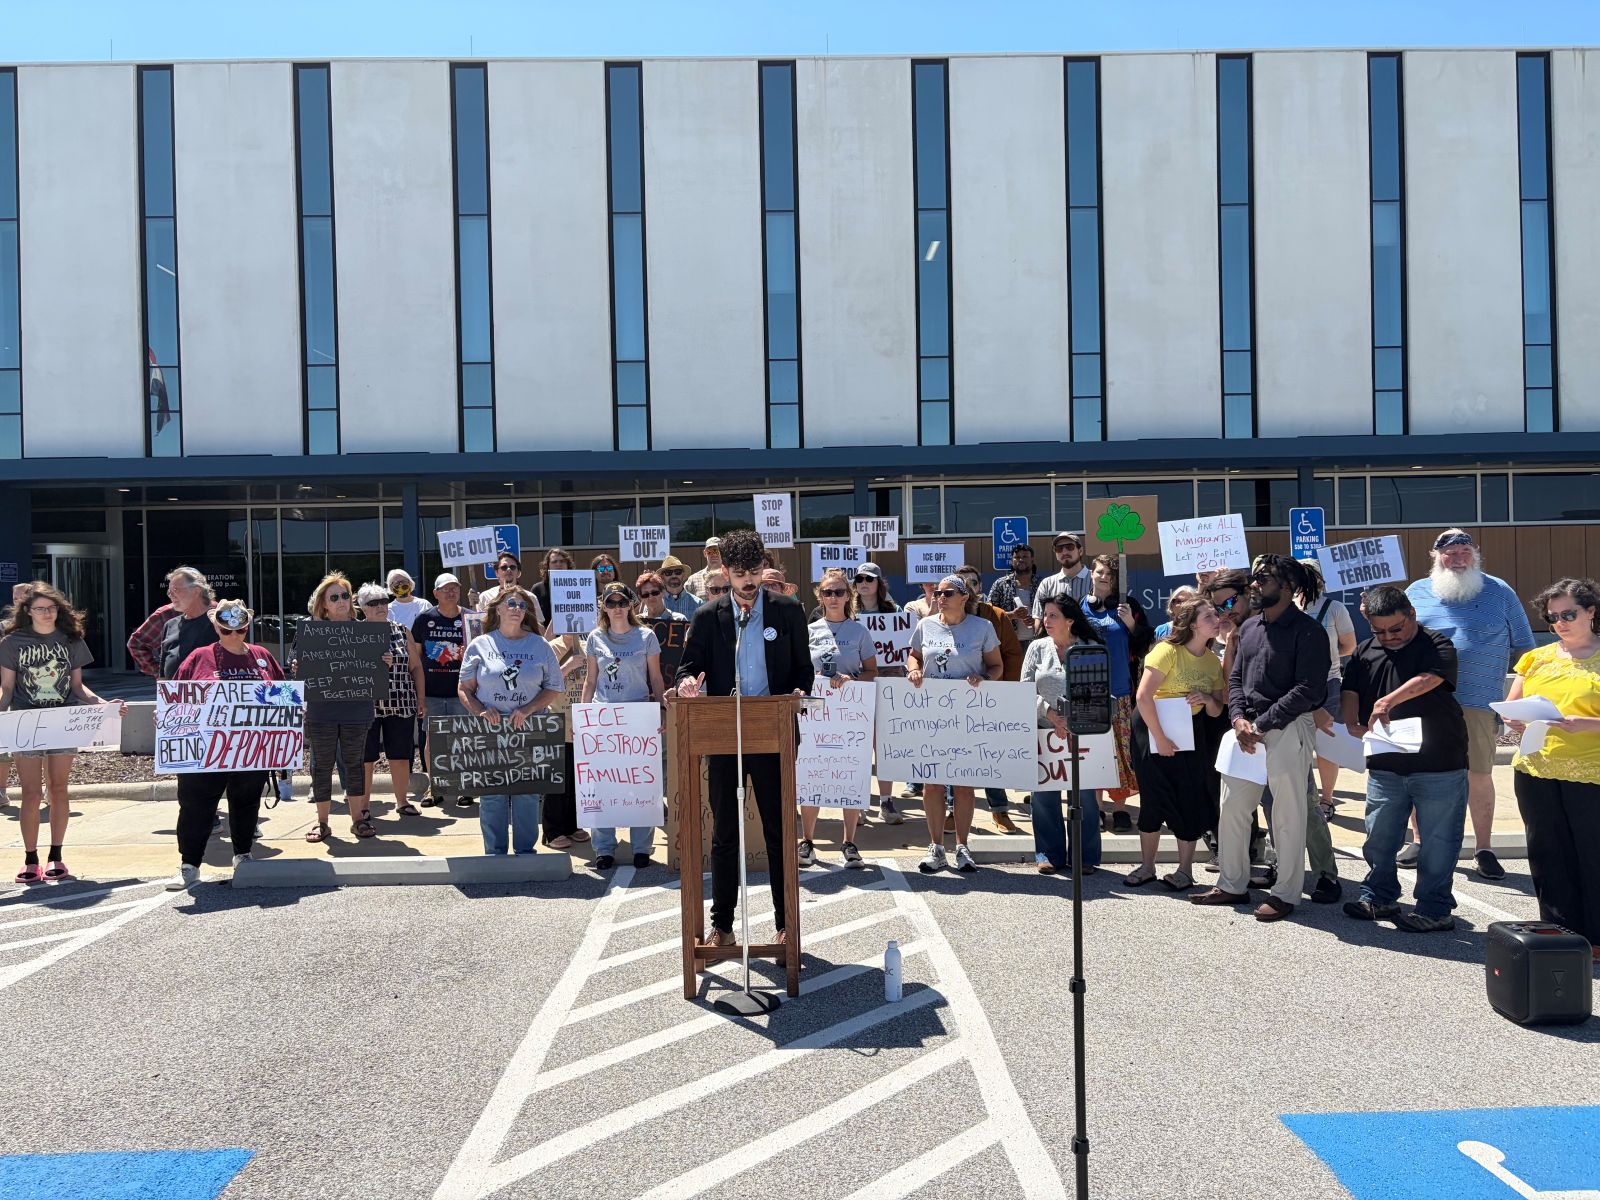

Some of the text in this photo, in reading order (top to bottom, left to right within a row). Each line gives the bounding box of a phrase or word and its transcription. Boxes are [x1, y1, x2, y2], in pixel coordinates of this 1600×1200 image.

[761, 499, 783, 511] STOP
[766, 516, 780, 527] ICE
[854, 520, 896, 532] LET THEM
[1217, 517, 1238, 530] ALL
[623, 528, 666, 540] LET THEM
[862, 533, 888, 550] OUT
[442, 537, 493, 559] ICE OUT
[632, 541, 658, 559] OUT
[820, 546, 859, 560] END ICE
[922, 552, 947, 561] ICE OFF
[1330, 538, 1385, 563] END ICE
[915, 564, 958, 575] OUR STREETS
[1337, 561, 1392, 586] TERROR
[553, 577, 593, 587] HANDS OFF
[566, 590, 581, 600] OUR
[554, 603, 594, 614] NEIGHBORS
[303, 623, 355, 637] AMERICAN
[868, 612, 912, 632] US IN
[430, 630, 463, 638] ILLEGAL
[301, 649, 357, 661] AMERICAN
[884, 646, 913, 665] OUT
[340, 676, 375, 686] THEM
[160, 681, 254, 705] WHY ARE
[319, 687, 373, 699] TOGETHER!
[511, 691, 528, 706] Life
[838, 684, 865, 706] YOU
[882, 685, 895, 712] 9
[230, 704, 303, 728] CITIZENS
[577, 706, 629, 729] ICE
[836, 707, 869, 722] THEM
[64, 722, 102, 732] WORSE
[888, 714, 1031, 738] Immigrant Detainees
[160, 730, 303, 769] BEING DEPORTED?
[451, 732, 531, 755] ARE NOT
[581, 731, 659, 757] DESTROYS
[433, 744, 566, 772] CRIMINALS BUT
[883, 743, 915, 760] Have
[972, 742, 1006, 764] They
[1005, 750, 1033, 760] are
[798, 754, 860, 771] mmigrants
[912, 761, 1002, 779] NOT Criminals
[459, 763, 551, 790] PRESIDENT
[576, 762, 656, 785] FAMILIES
[831, 770, 858, 781] NOT
[808, 794, 821, 805] 47
